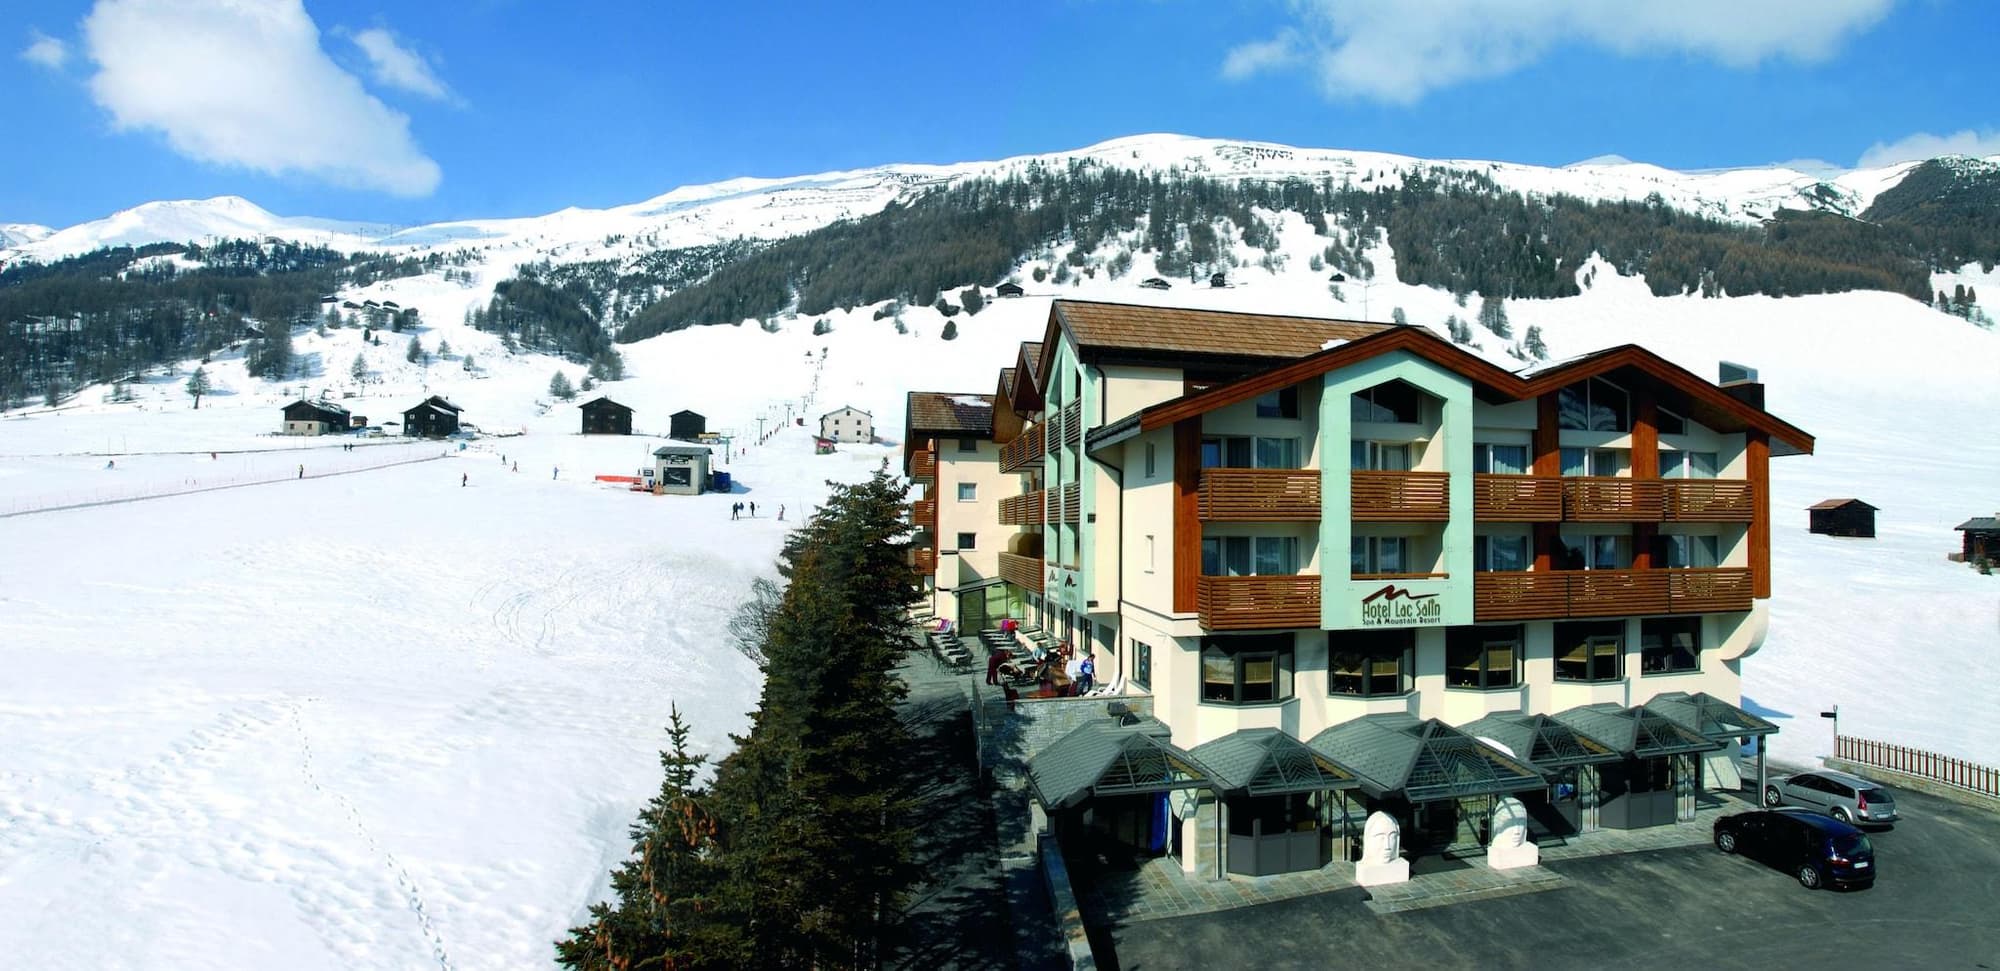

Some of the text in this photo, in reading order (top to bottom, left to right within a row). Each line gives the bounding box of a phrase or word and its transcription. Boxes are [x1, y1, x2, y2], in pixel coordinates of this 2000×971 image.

[1362, 599, 1441, 618] Hotel Lac Salin
[1362, 616, 1441, 625] Spa & Mountain Resort
